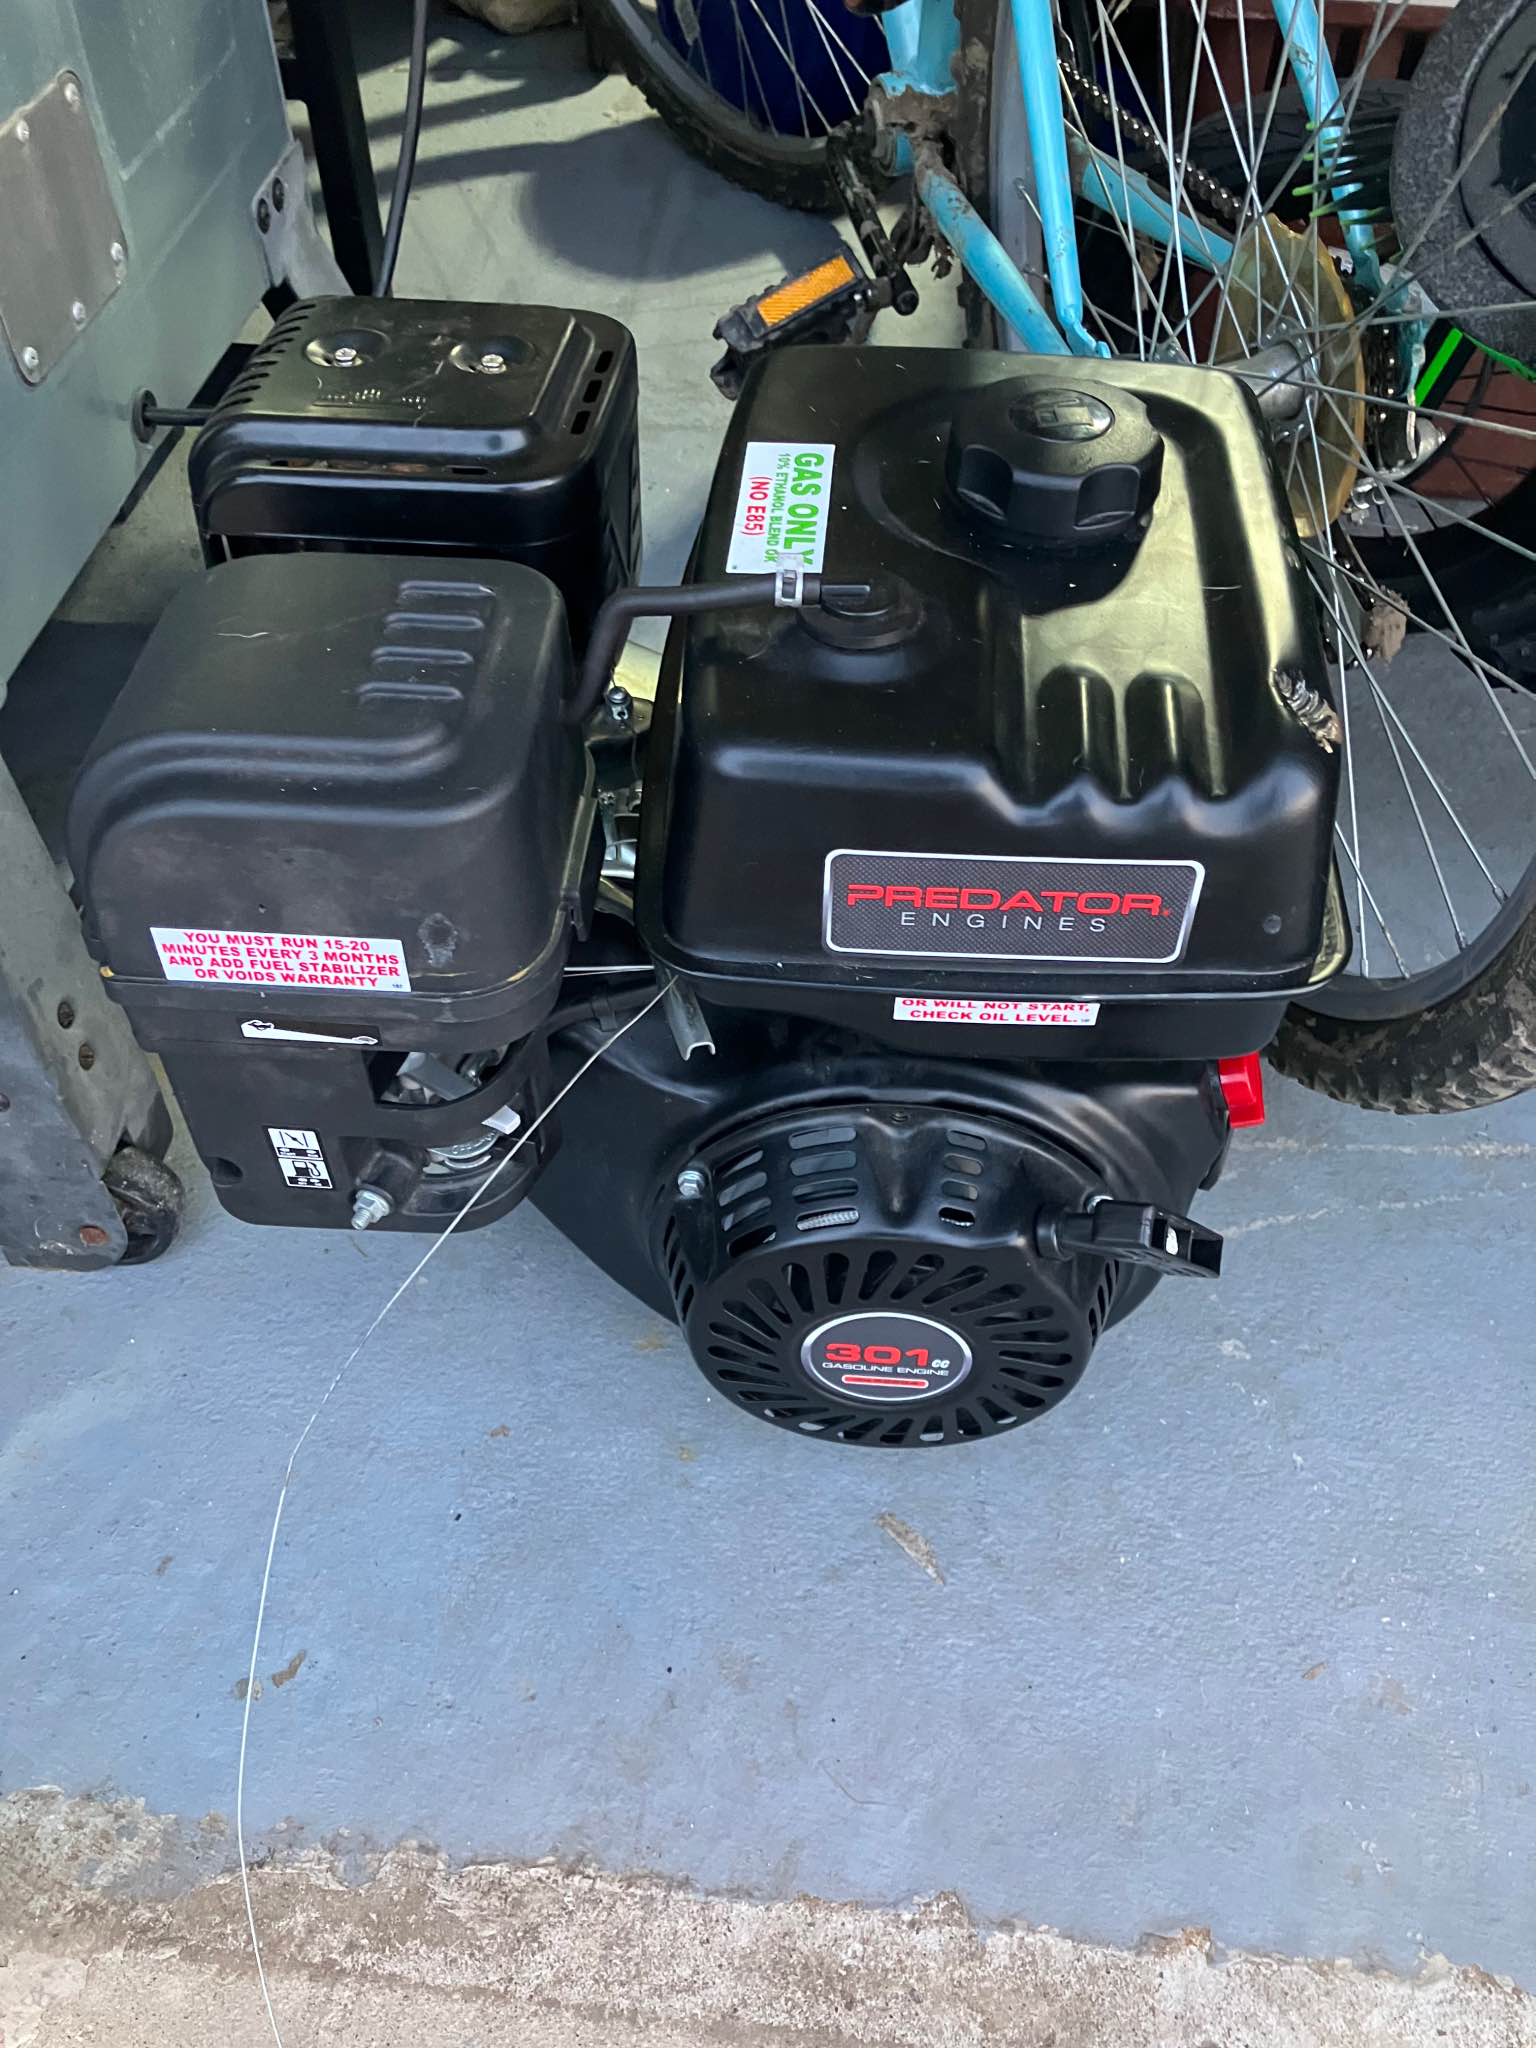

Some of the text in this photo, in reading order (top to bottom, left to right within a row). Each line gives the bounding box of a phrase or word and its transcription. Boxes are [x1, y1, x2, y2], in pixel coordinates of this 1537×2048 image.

[790, 452, 824, 496] GAS
[771, 472, 789, 513] ETHANOL
[740, 476, 773, 536] (NO E85)
[766, 516, 783, 546] BLEND
[763, 548, 779, 563] OK
[900, 911, 1106, 933] ENGINES
[184, 932, 370, 952] YOU MUST RUN 15-20
[161, 943, 400, 965] MINUTES EVERY 3 MONTHS
[169, 955, 401, 977] AND ADD FUEL STABILIZER
[195, 968, 219, 979] OR
[223, 970, 276, 983] VOIDS
[281, 973, 378, 988] WARRANTY
[902, 999, 927, 1007] OR
[933, 1000, 977, 1009] WILL
[983, 1002, 1024, 1011] NOT
[910, 1010, 972, 1021] CHECK
[979, 1012, 1009, 1022] OIL
[1015, 1013, 1078, 1023] LEVEL.
[825, 1343, 929, 1367] 301
[822, 1361, 950, 1377] GASOLINE ENGINE
